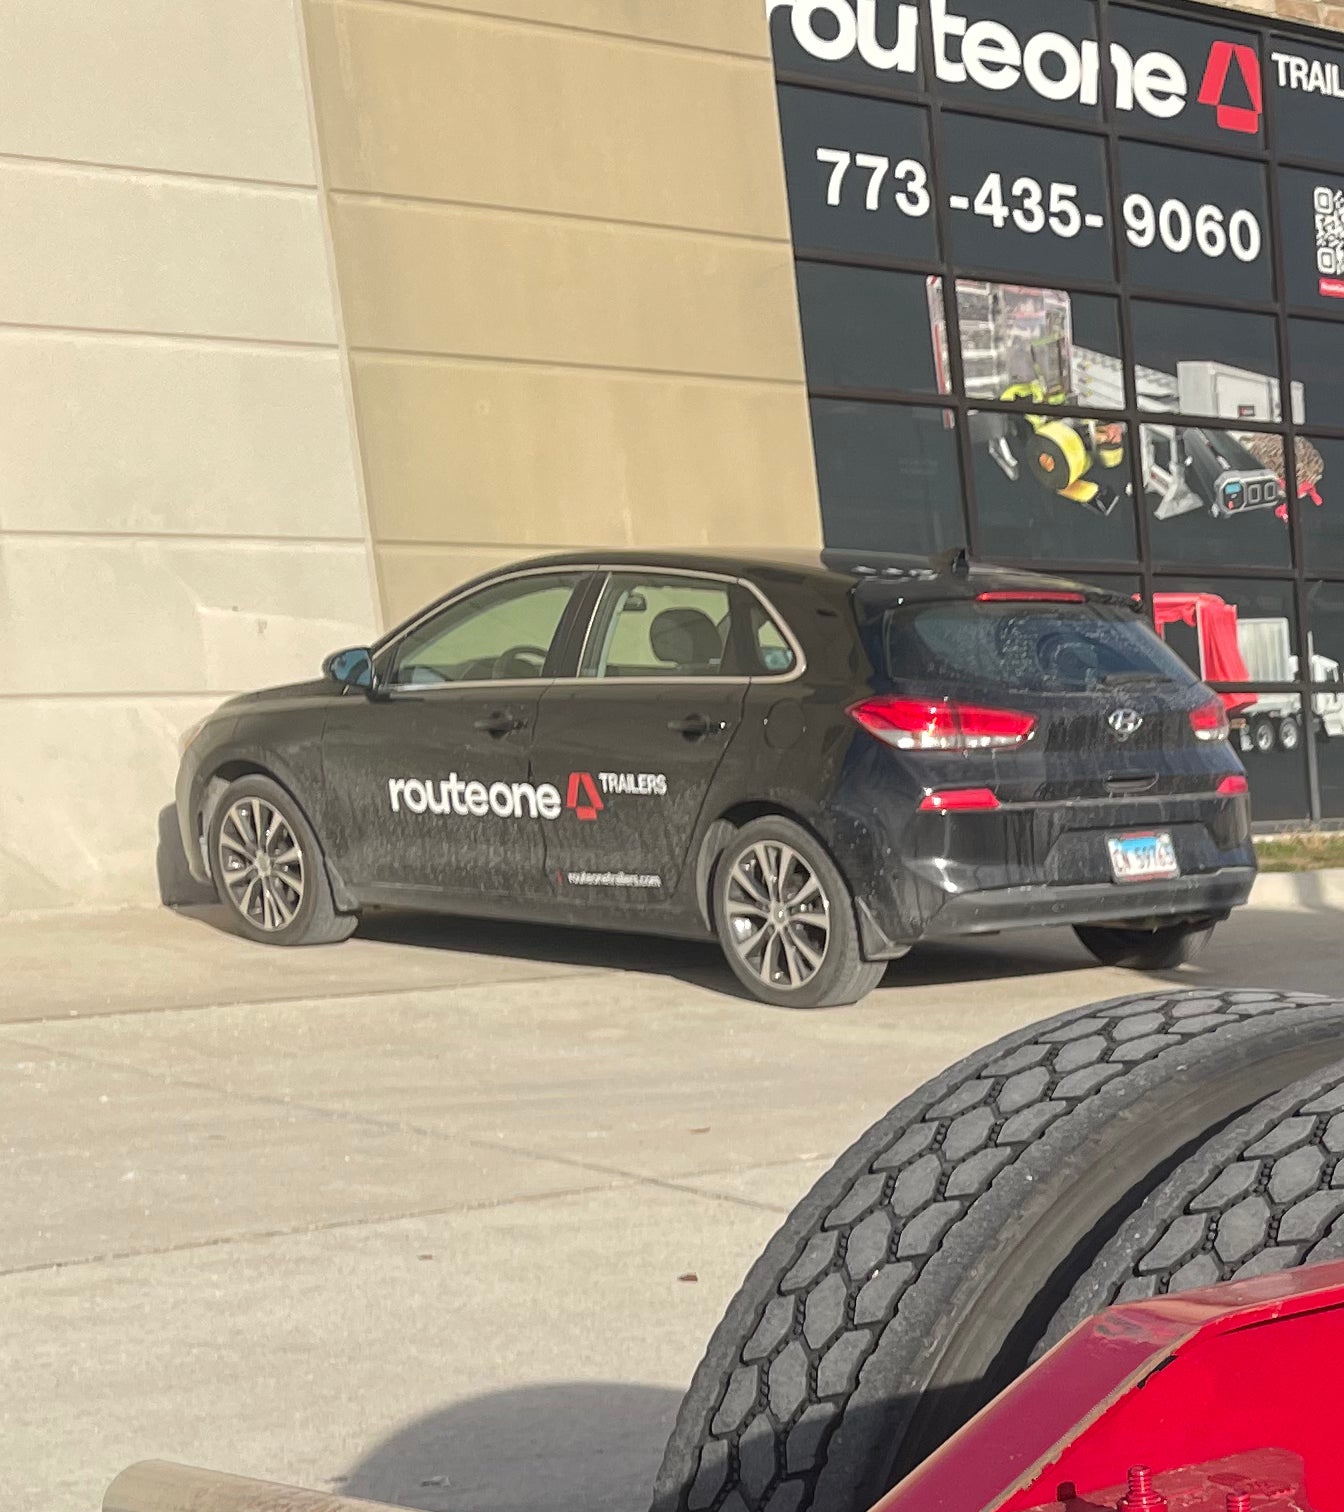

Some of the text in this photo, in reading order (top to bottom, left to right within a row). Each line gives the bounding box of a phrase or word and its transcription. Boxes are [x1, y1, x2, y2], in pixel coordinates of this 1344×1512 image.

[816, 147, 931, 217] 773
[1123, 193, 1261, 262] 9060
[388, 772, 667, 820] routeone TRAILERS
